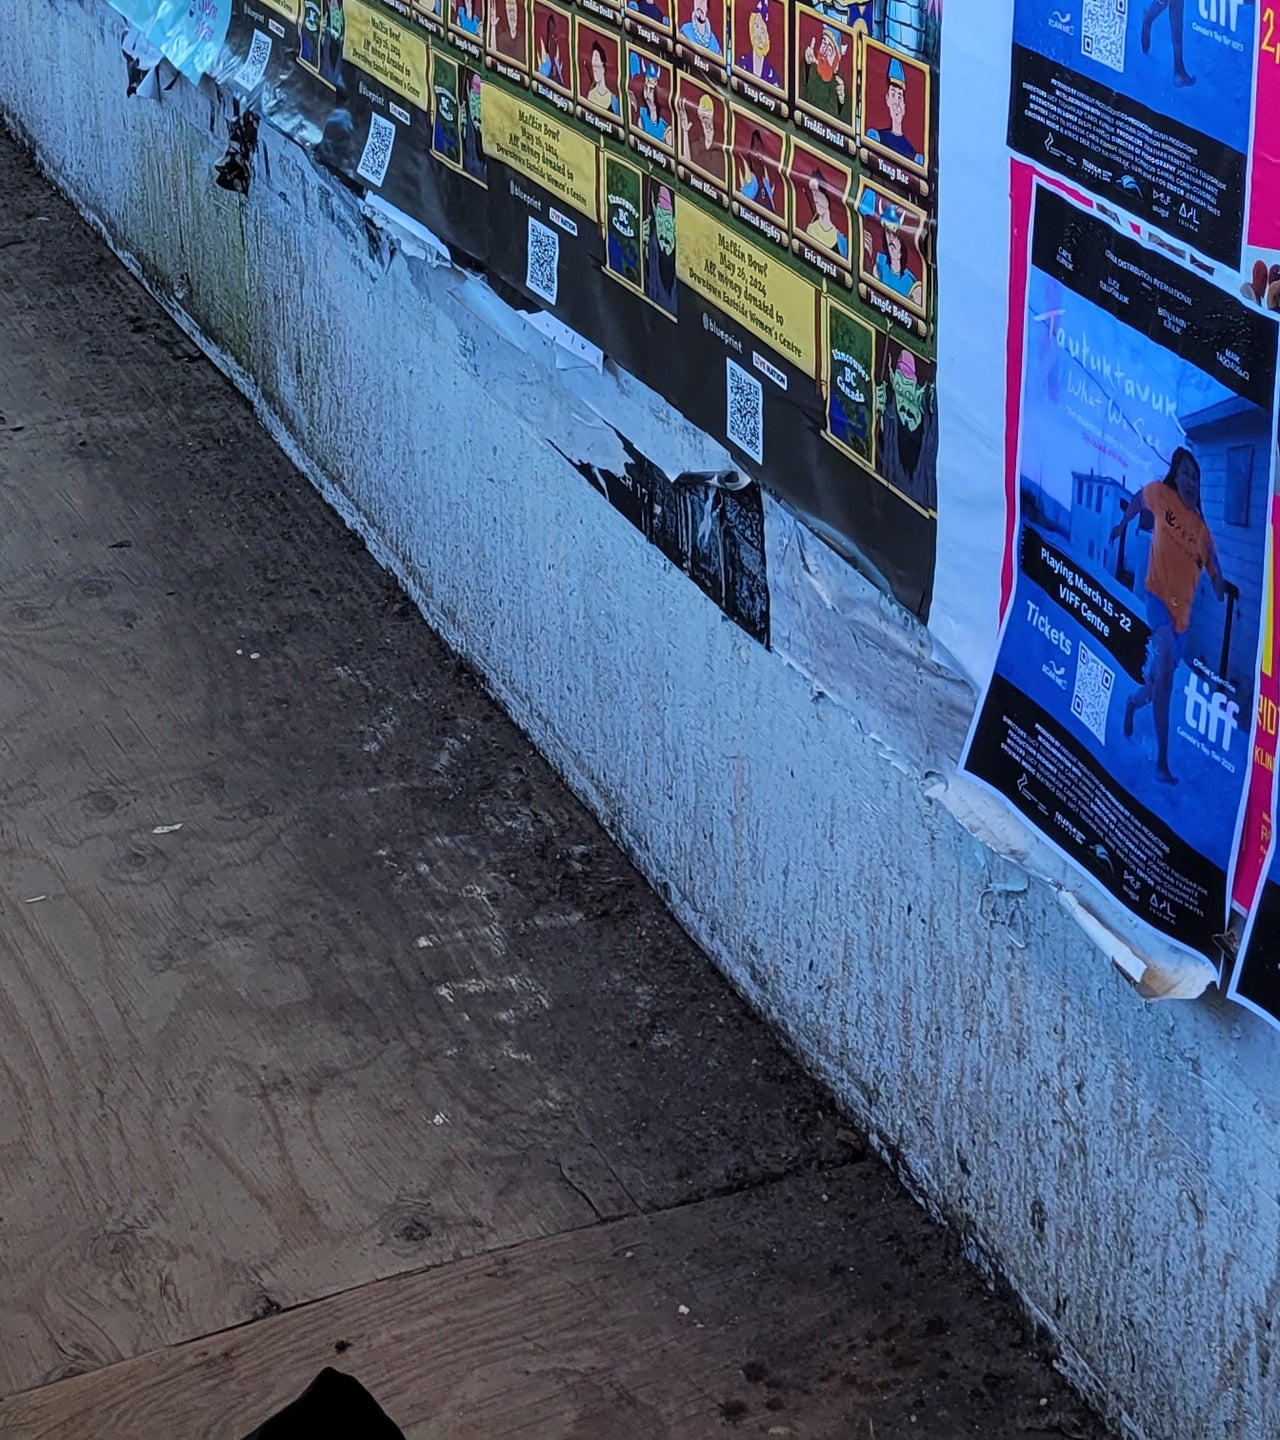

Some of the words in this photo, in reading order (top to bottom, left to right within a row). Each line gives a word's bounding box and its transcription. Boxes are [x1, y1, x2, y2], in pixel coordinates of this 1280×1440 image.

[826, 127, 844, 148] Dredd
[878, 159, 894, 178] Yung
[1026, 599, 1072, 656] Tickets
[1184, 672, 1240, 752] tiff
